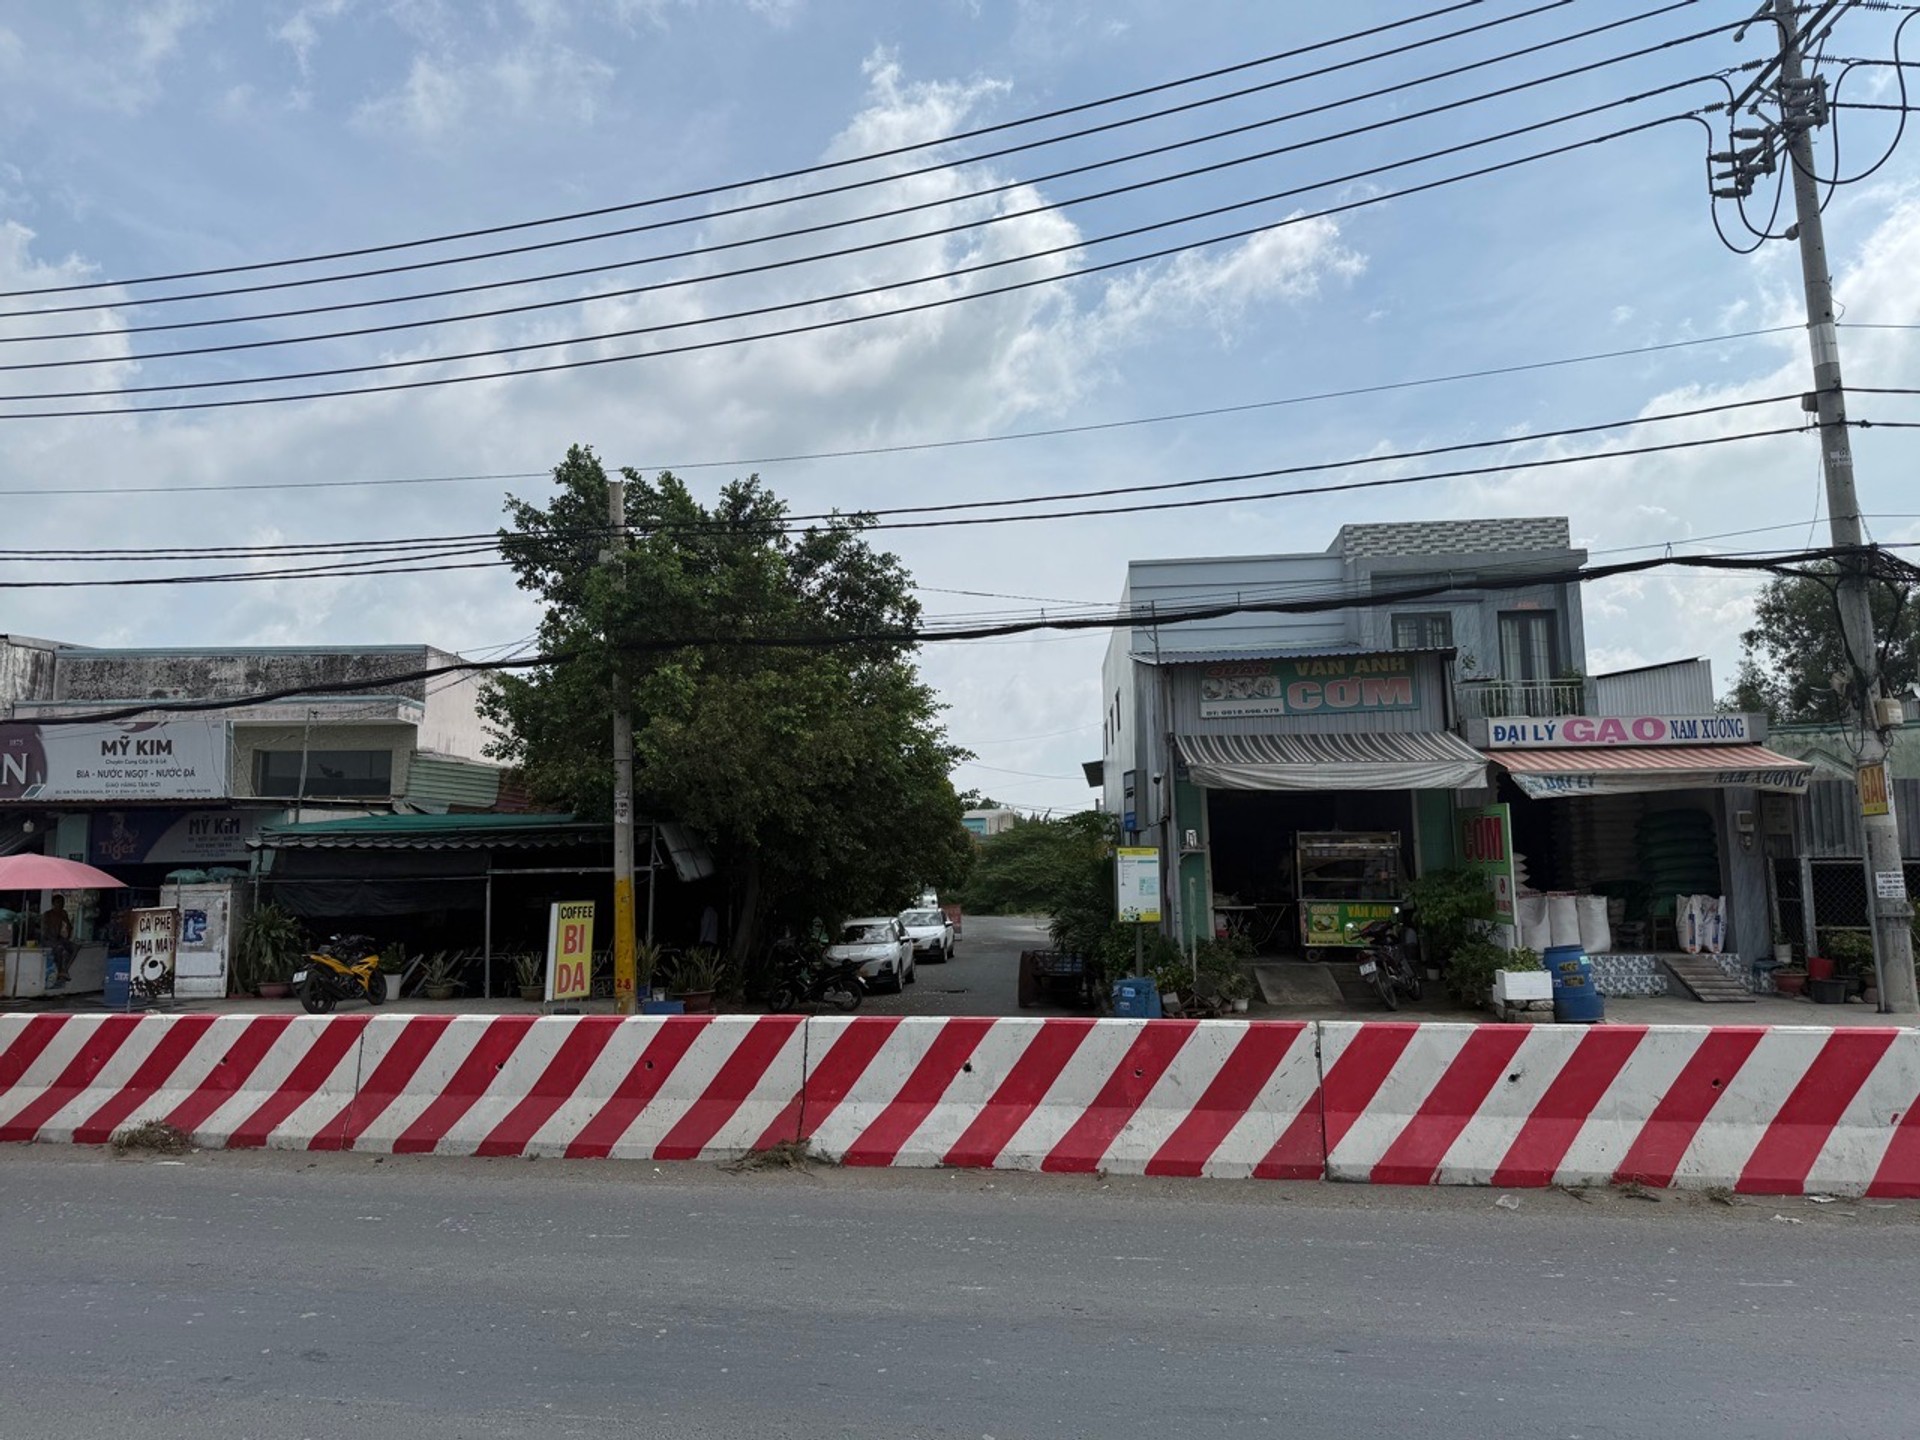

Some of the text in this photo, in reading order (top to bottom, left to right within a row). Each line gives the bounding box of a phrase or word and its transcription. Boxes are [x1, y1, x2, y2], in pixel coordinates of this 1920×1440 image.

[1353, 656, 1406, 673] ANH
[1286, 675, 1413, 711] CƠM
[1493, 716, 1745, 745] ĐẠI LÝ GẠO NAM XƯƠNG
[101, 735, 173, 756] MỸ KIM
[76, 769, 90, 778] BIA
[97, 768, 122, 778] NƯỚC
[124, 769, 149, 781] NGỌT
[156, 767, 182, 778] NƯỚC
[183, 766, 196, 777] ĐÁ
[188, 815, 210, 835] MỸ
[1463, 813, 1505, 863] CƠM
[98, 840, 137, 861] Tiger
[560, 906, 594, 920] COFFEE
[134, 933, 176, 956] PHA MÁY
[564, 924, 585, 955] BI
[557, 962, 585, 994] DA
